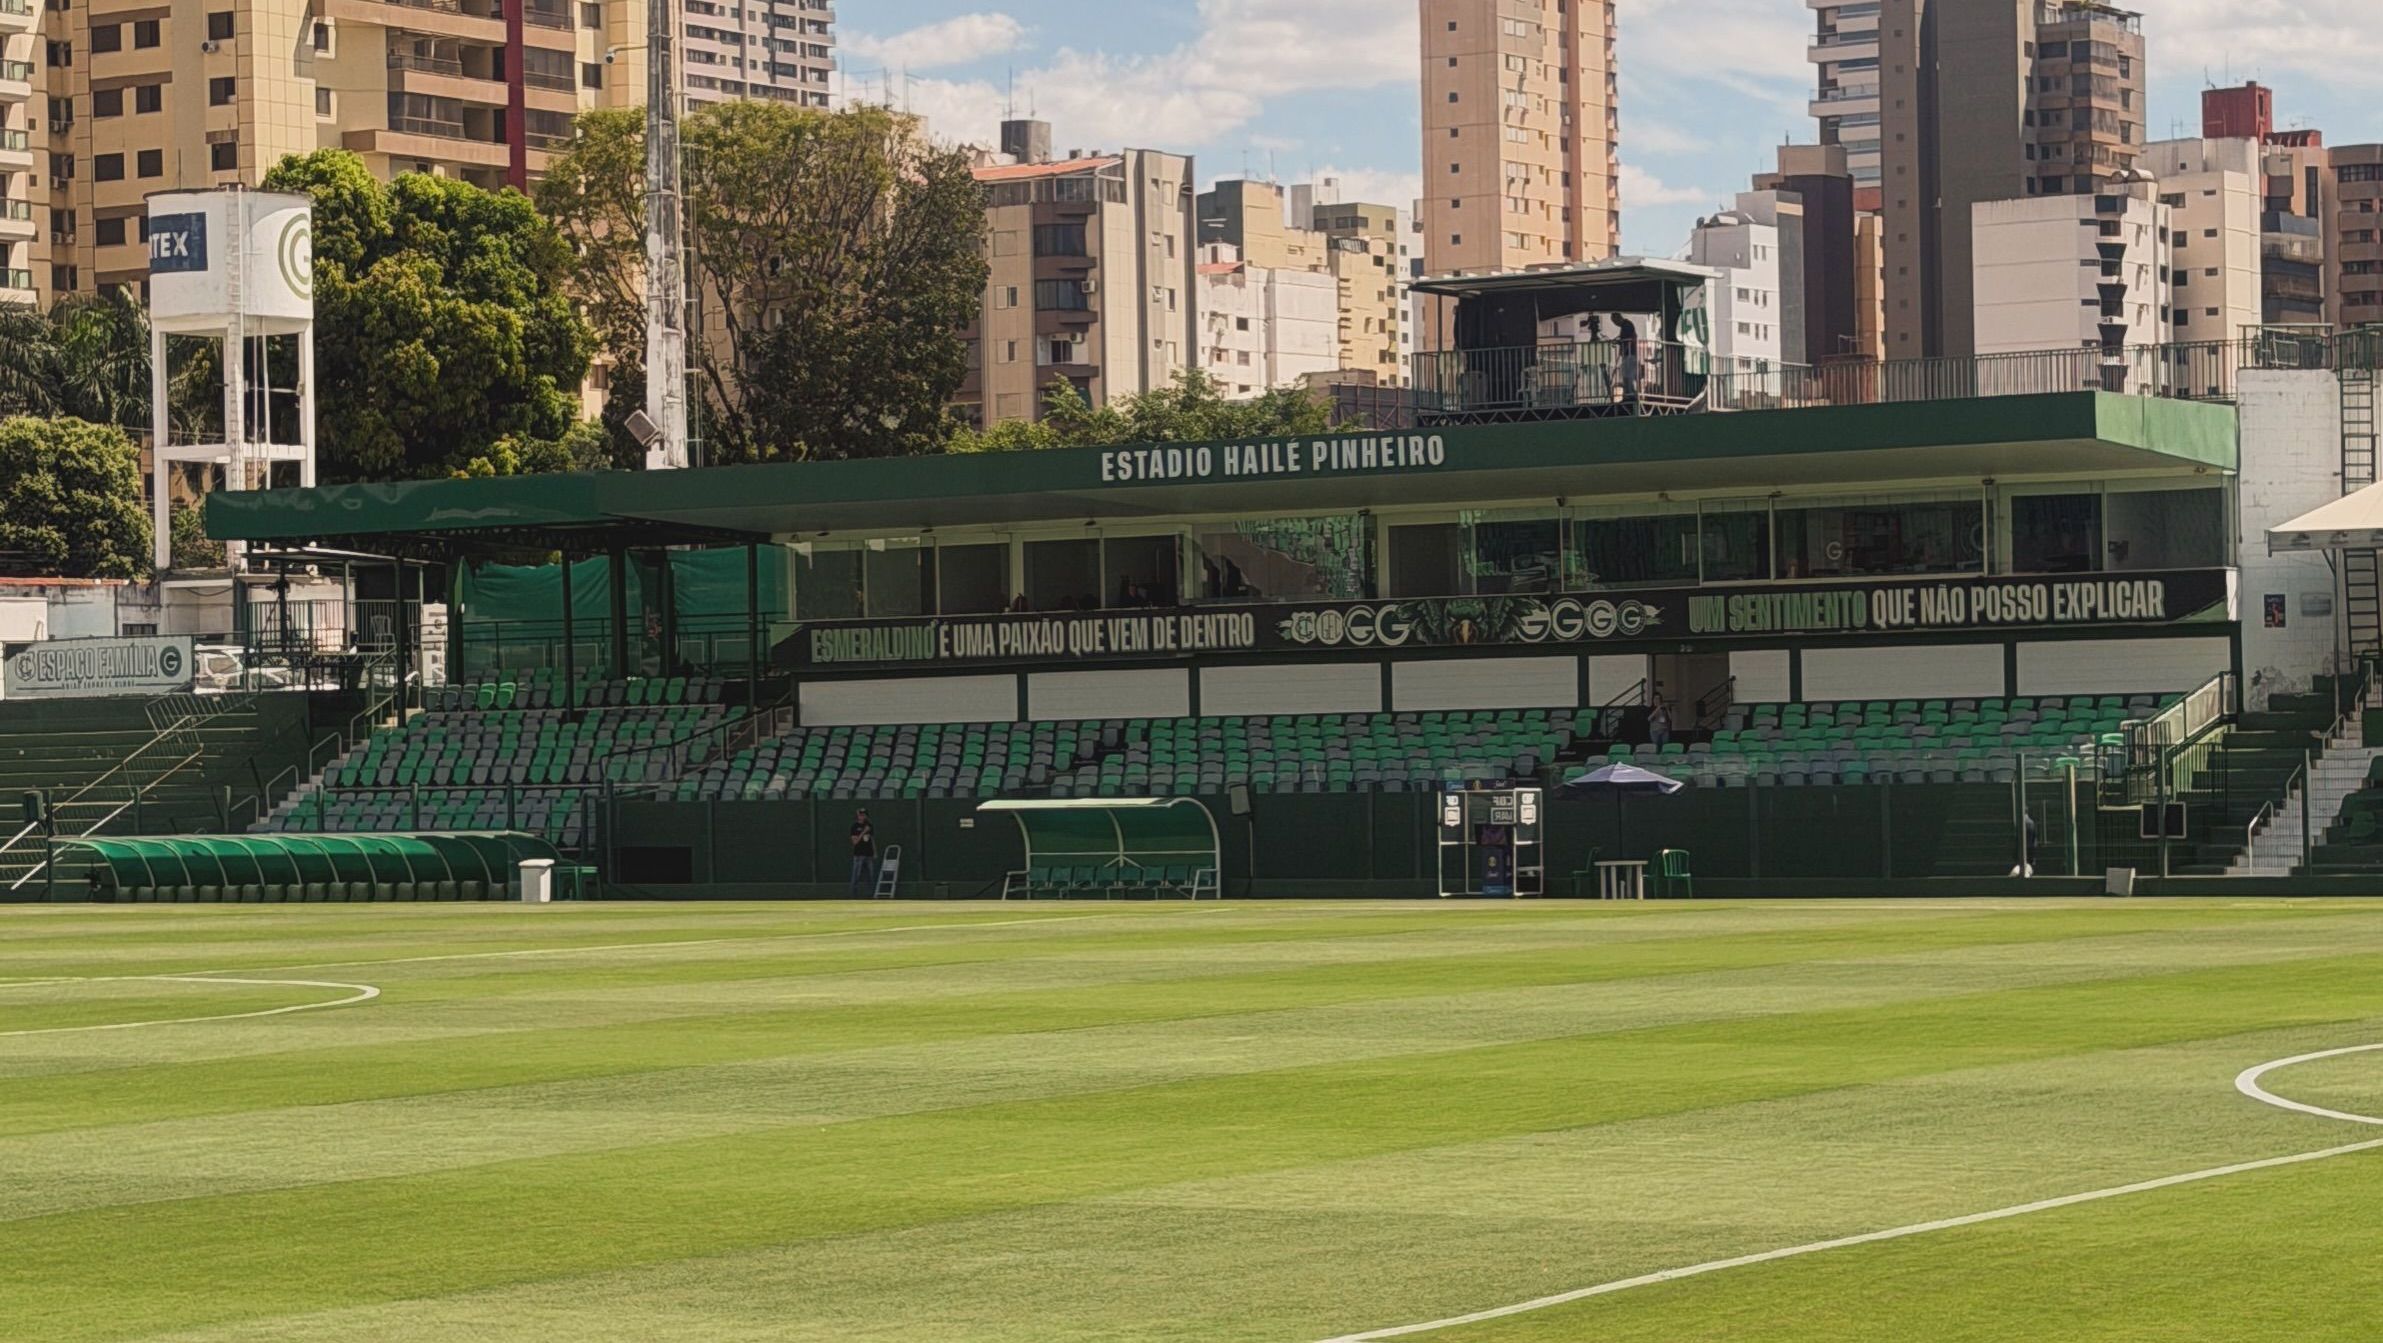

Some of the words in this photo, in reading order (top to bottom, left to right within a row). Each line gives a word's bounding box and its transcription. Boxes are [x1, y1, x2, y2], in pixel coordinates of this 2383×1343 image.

[1102, 446, 1212, 481] ESTÁDIO
[1224, 438, 1301, 475] HAILÉ
[1312, 435, 1445, 470] PINHEIRO
[1688, 595, 1726, 632] UM
[1729, 590, 1867, 631] SENTIMENTO
[1872, 588, 1915, 628] QUE
[1920, 584, 1965, 624] NÃO
[1971, 584, 2048, 623] POSSO
[2053, 580, 2166, 620] EXPLICAR
[811, 625, 936, 663] ESMERALDINO
[939, 621, 950, 658] É
[953, 623, 995, 658] UMA
[999, 618, 1065, 656] PAIXÃO
[1069, 619, 1105, 656] QUE
[1107, 617, 1149, 652] VEM
[1152, 616, 1177, 650] DE
[1180, 612, 1255, 649] DENTRO
[37, 648, 95, 683] ESPAÇO
[98, 643, 158, 678] FAMÍLIA
